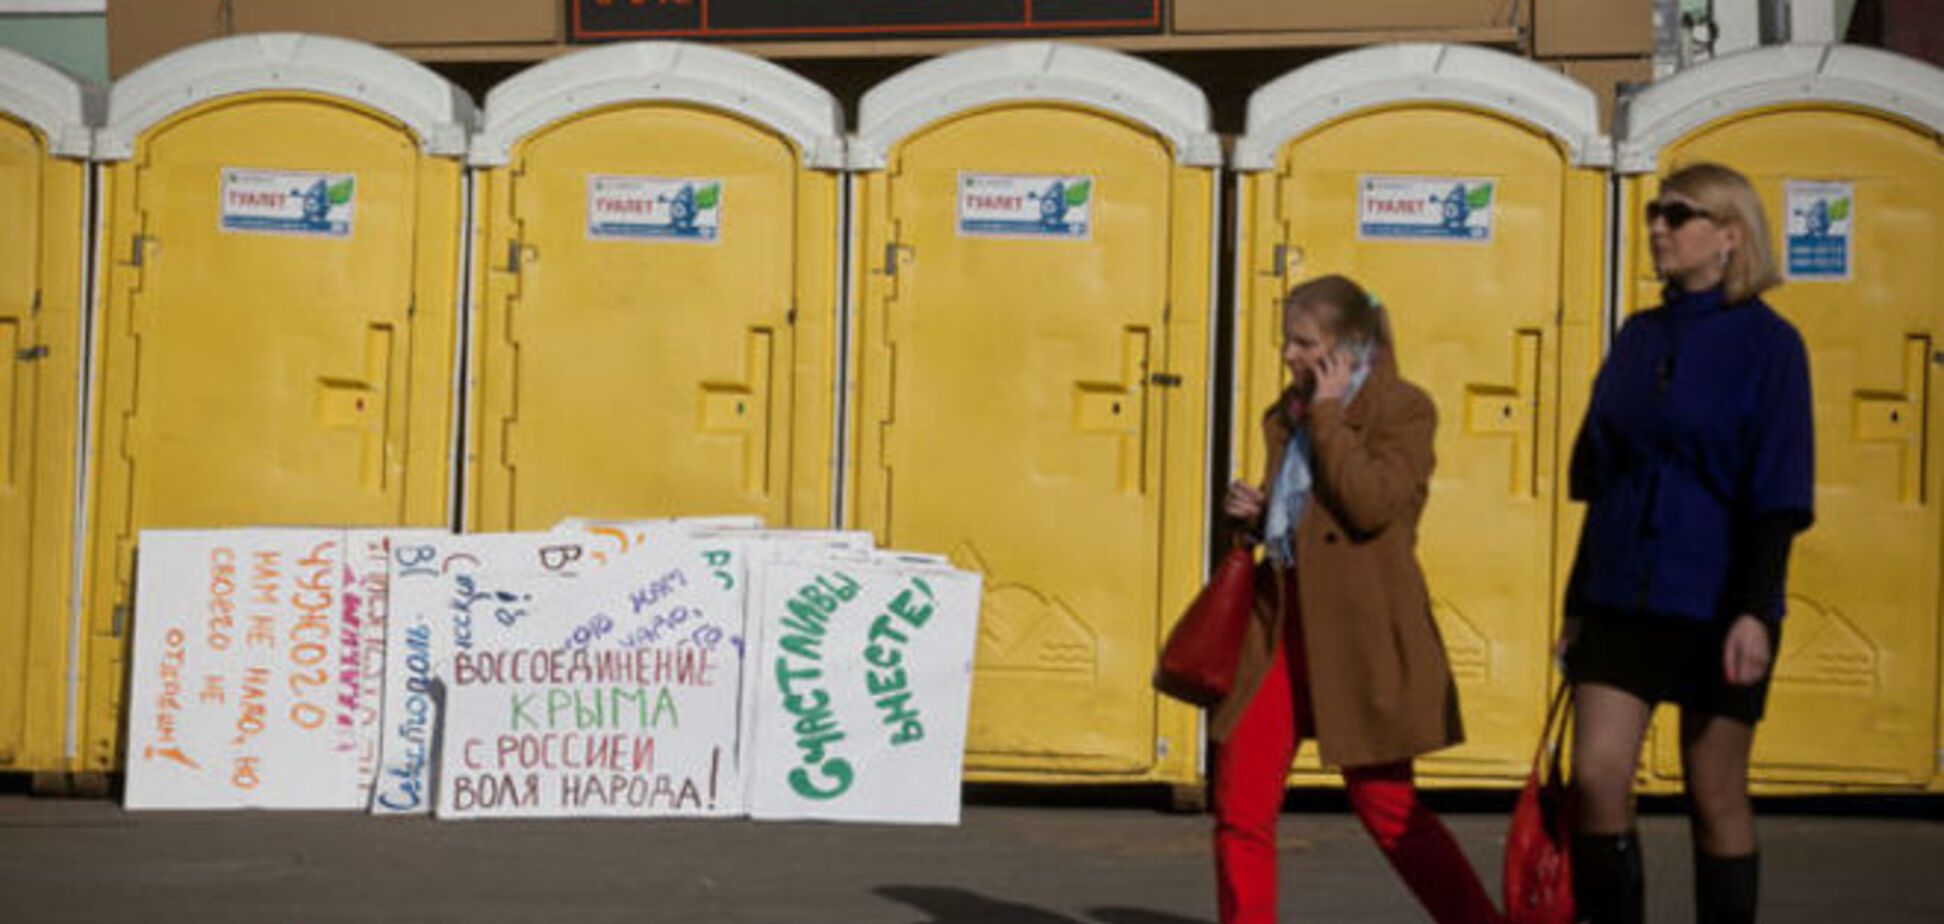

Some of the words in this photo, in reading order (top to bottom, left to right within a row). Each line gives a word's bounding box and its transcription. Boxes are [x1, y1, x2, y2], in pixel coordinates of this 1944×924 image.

[230, 191, 284, 207] ТУАЛЕТ
[252, 551, 281, 605] НАМ
[247, 615, 276, 648] НЕ
[454, 647, 717, 687] ВОССОЕДИНЕНИЕ
[200, 675, 226, 704] НЕ
[511, 687, 679, 731] КРЫМА
[232, 756, 260, 791] НО
[453, 773, 540, 811] ВОЛЯ
[561, 745, 721, 811] НАРОДА!
